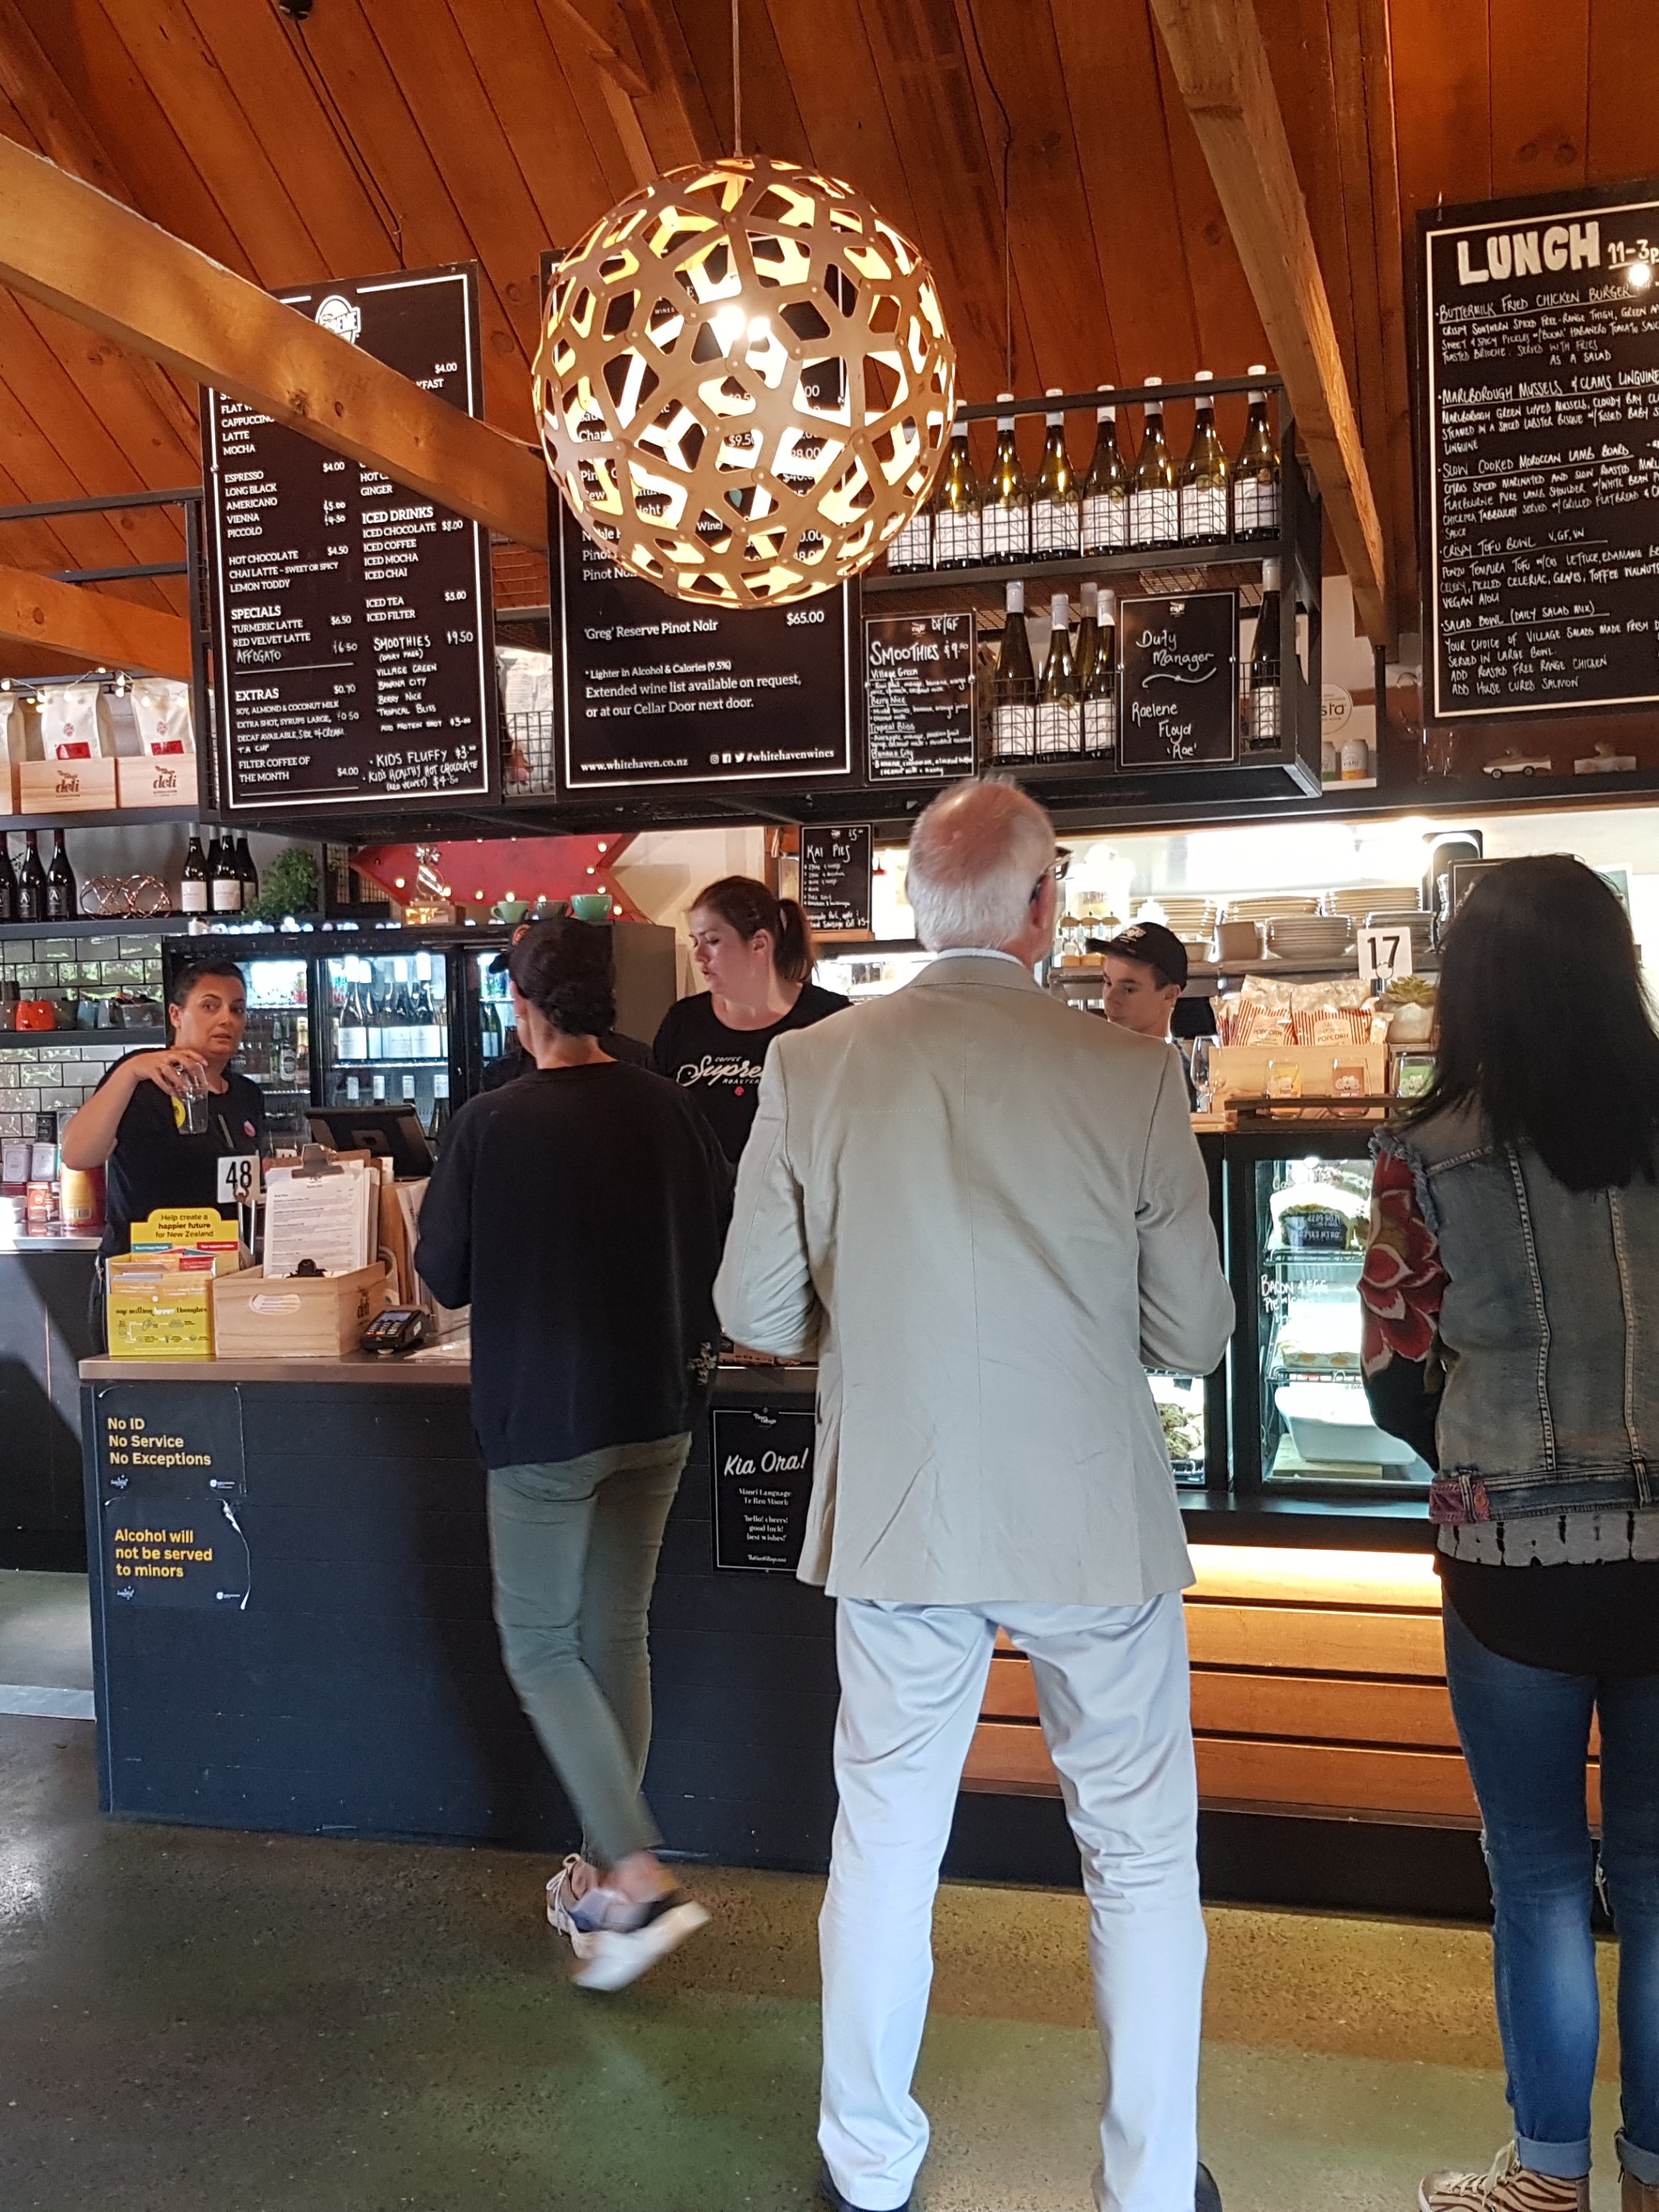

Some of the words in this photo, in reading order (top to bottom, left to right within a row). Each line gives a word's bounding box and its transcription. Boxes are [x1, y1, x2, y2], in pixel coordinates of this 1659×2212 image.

[1457, 221, 1601, 286] LUNCH
[1439, 302, 1497, 323] BUTTERMILK
[1502, 293, 1528, 313] FRIED
[1536, 290, 1579, 307] CHICKEN
[1589, 283, 1631, 302] BURGER
[1550, 354, 1561, 365] AS
[1584, 349, 1611, 363] SALAD
[1442, 386, 1513, 405] MARLBOROUGH
[1519, 382, 1563, 399] MUSSELS
[1580, 375, 1611, 390] CLAMS
[223, 431, 250, 442] LATTE
[223, 444, 256, 455] MOCHA
[323, 462, 345, 473] $4.00
[1442, 462, 1469, 478] SLOW
[1479, 459, 1514, 474] COOKED
[1519, 452, 1561, 469] MOROCCAN
[1568, 447, 1594, 462] LAMB
[1601, 443, 1629, 457] BOARD
[224, 471, 263, 483] ESPRESSO
[225, 487, 248, 497] LONG
[250, 483, 276, 494] BLACK
[227, 498, 277, 511] AMERICANO
[227, 513, 260, 524] VIENNA
[362, 512, 388, 525] ICED
[390, 506, 433, 522] DRINKS
[227, 527, 262, 538] PICCOLO
[363, 528, 383, 538] ICED
[384, 523, 436, 536] CHOCOLATE
[327, 545, 349, 556] $4.50
[363, 542, 383, 552] ICED
[385, 539, 417, 550] COFFEE
[1477, 538, 1501, 556] TOFU
[1506, 536, 1536, 550] BOWL
[229, 556, 247, 565] HOT
[248, 551, 299, 563] CHOCOLATE
[583, 568, 612, 581] Pinot
[366, 598, 386, 608] ICED
[387, 597, 404, 606] TEA
[445, 591, 466, 602] $5.00
[1442, 594, 1473, 610] VEGAN
[231, 605, 281, 620] SPECIALS
[786, 611, 824, 626] $65.00
[1444, 618, 1472, 632] SALAD
[1479, 614, 1504, 627] BOWL
[1542, 605, 1569, 618] SALAD
[232, 622, 275, 634] TURMERIC
[276, 619, 303, 630] LATTE
[330, 615, 352, 626] $6.50
[616, 624, 659, 637] Reserve
[661, 622, 690, 635] Pinot
[694, 620, 718, 632] Noir
[233, 638, 250, 647] RED
[251, 635, 283, 645] VELVET
[284, 632, 311, 643] LATTE
[373, 634, 431, 651] SMOOTHIES
[1135, 630, 1177, 652] Duty
[870, 641, 939, 666] SMOOTHIES
[1153, 649, 1214, 672] Manager
[591, 670, 620, 680] Lighter
[621, 668, 630, 677] in
[632, 665, 664, 676] Alcohol
[664, 665, 671, 674] &
[673, 663, 707, 674] Calories
[235, 687, 279, 701] EXTRAS
[586, 687, 637, 699] Extended
[639, 685, 667, 695] wine
[670, 682, 686, 693] list
[688, 678, 737, 691] available
[740, 679, 754, 688] on
[756, 674, 801, 689] request,
[586, 709, 598, 718] or
[600, 707, 611, 716] at
[613, 707, 631, 716] our
[634, 703, 666, 715] Cellar
[668, 701, 696, 713] Door
[698, 700, 724, 710] next
[726, 697, 753, 709] door.
[1132, 702, 1177, 728] Raelene
[1158, 719, 1191, 744] Floyd
[376, 753, 402, 767] KIDS
[407, 750, 447, 763] FLUFFY
[747, 747, 834, 763] #whitehavenwines
[239, 759, 266, 769] FILTER
[267, 757, 297, 767] COFFEE
[299, 757, 310, 765] OF
[581, 757, 688, 771] www.whitehaven.co.nz
[239, 773, 257, 783] THE
[257, 771, 290, 781] MONTH
[337, 767, 359, 777] $4.00
[55, 780, 79, 793] deli
[153, 775, 177, 788] deli
[807, 845, 823, 863] KAI
[1367, 935, 1400, 970] 17
[226, 1159, 251, 1190] 48
[1261, 1274, 1293, 1296] BACON
[108, 1418, 127, 1430] No
[131, 1418, 145, 1429] ID
[109, 1435, 127, 1447] No
[131, 1435, 184, 1448] Service
[109, 1452, 128, 1464] No
[132, 1453, 211, 1467] Exceptions
[724, 1455, 756, 1476] Kia
[760, 1447, 809, 1473] Ora!
[114, 1529, 166, 1542] Alcohol
[170, 1530, 194, 1543] will
[115, 1548, 138, 1559] not
[142, 1547, 161, 1559] be
[164, 1548, 213, 1561] served
[117, 1565, 131, 1575] to
[134, 1565, 184, 1577] minors
